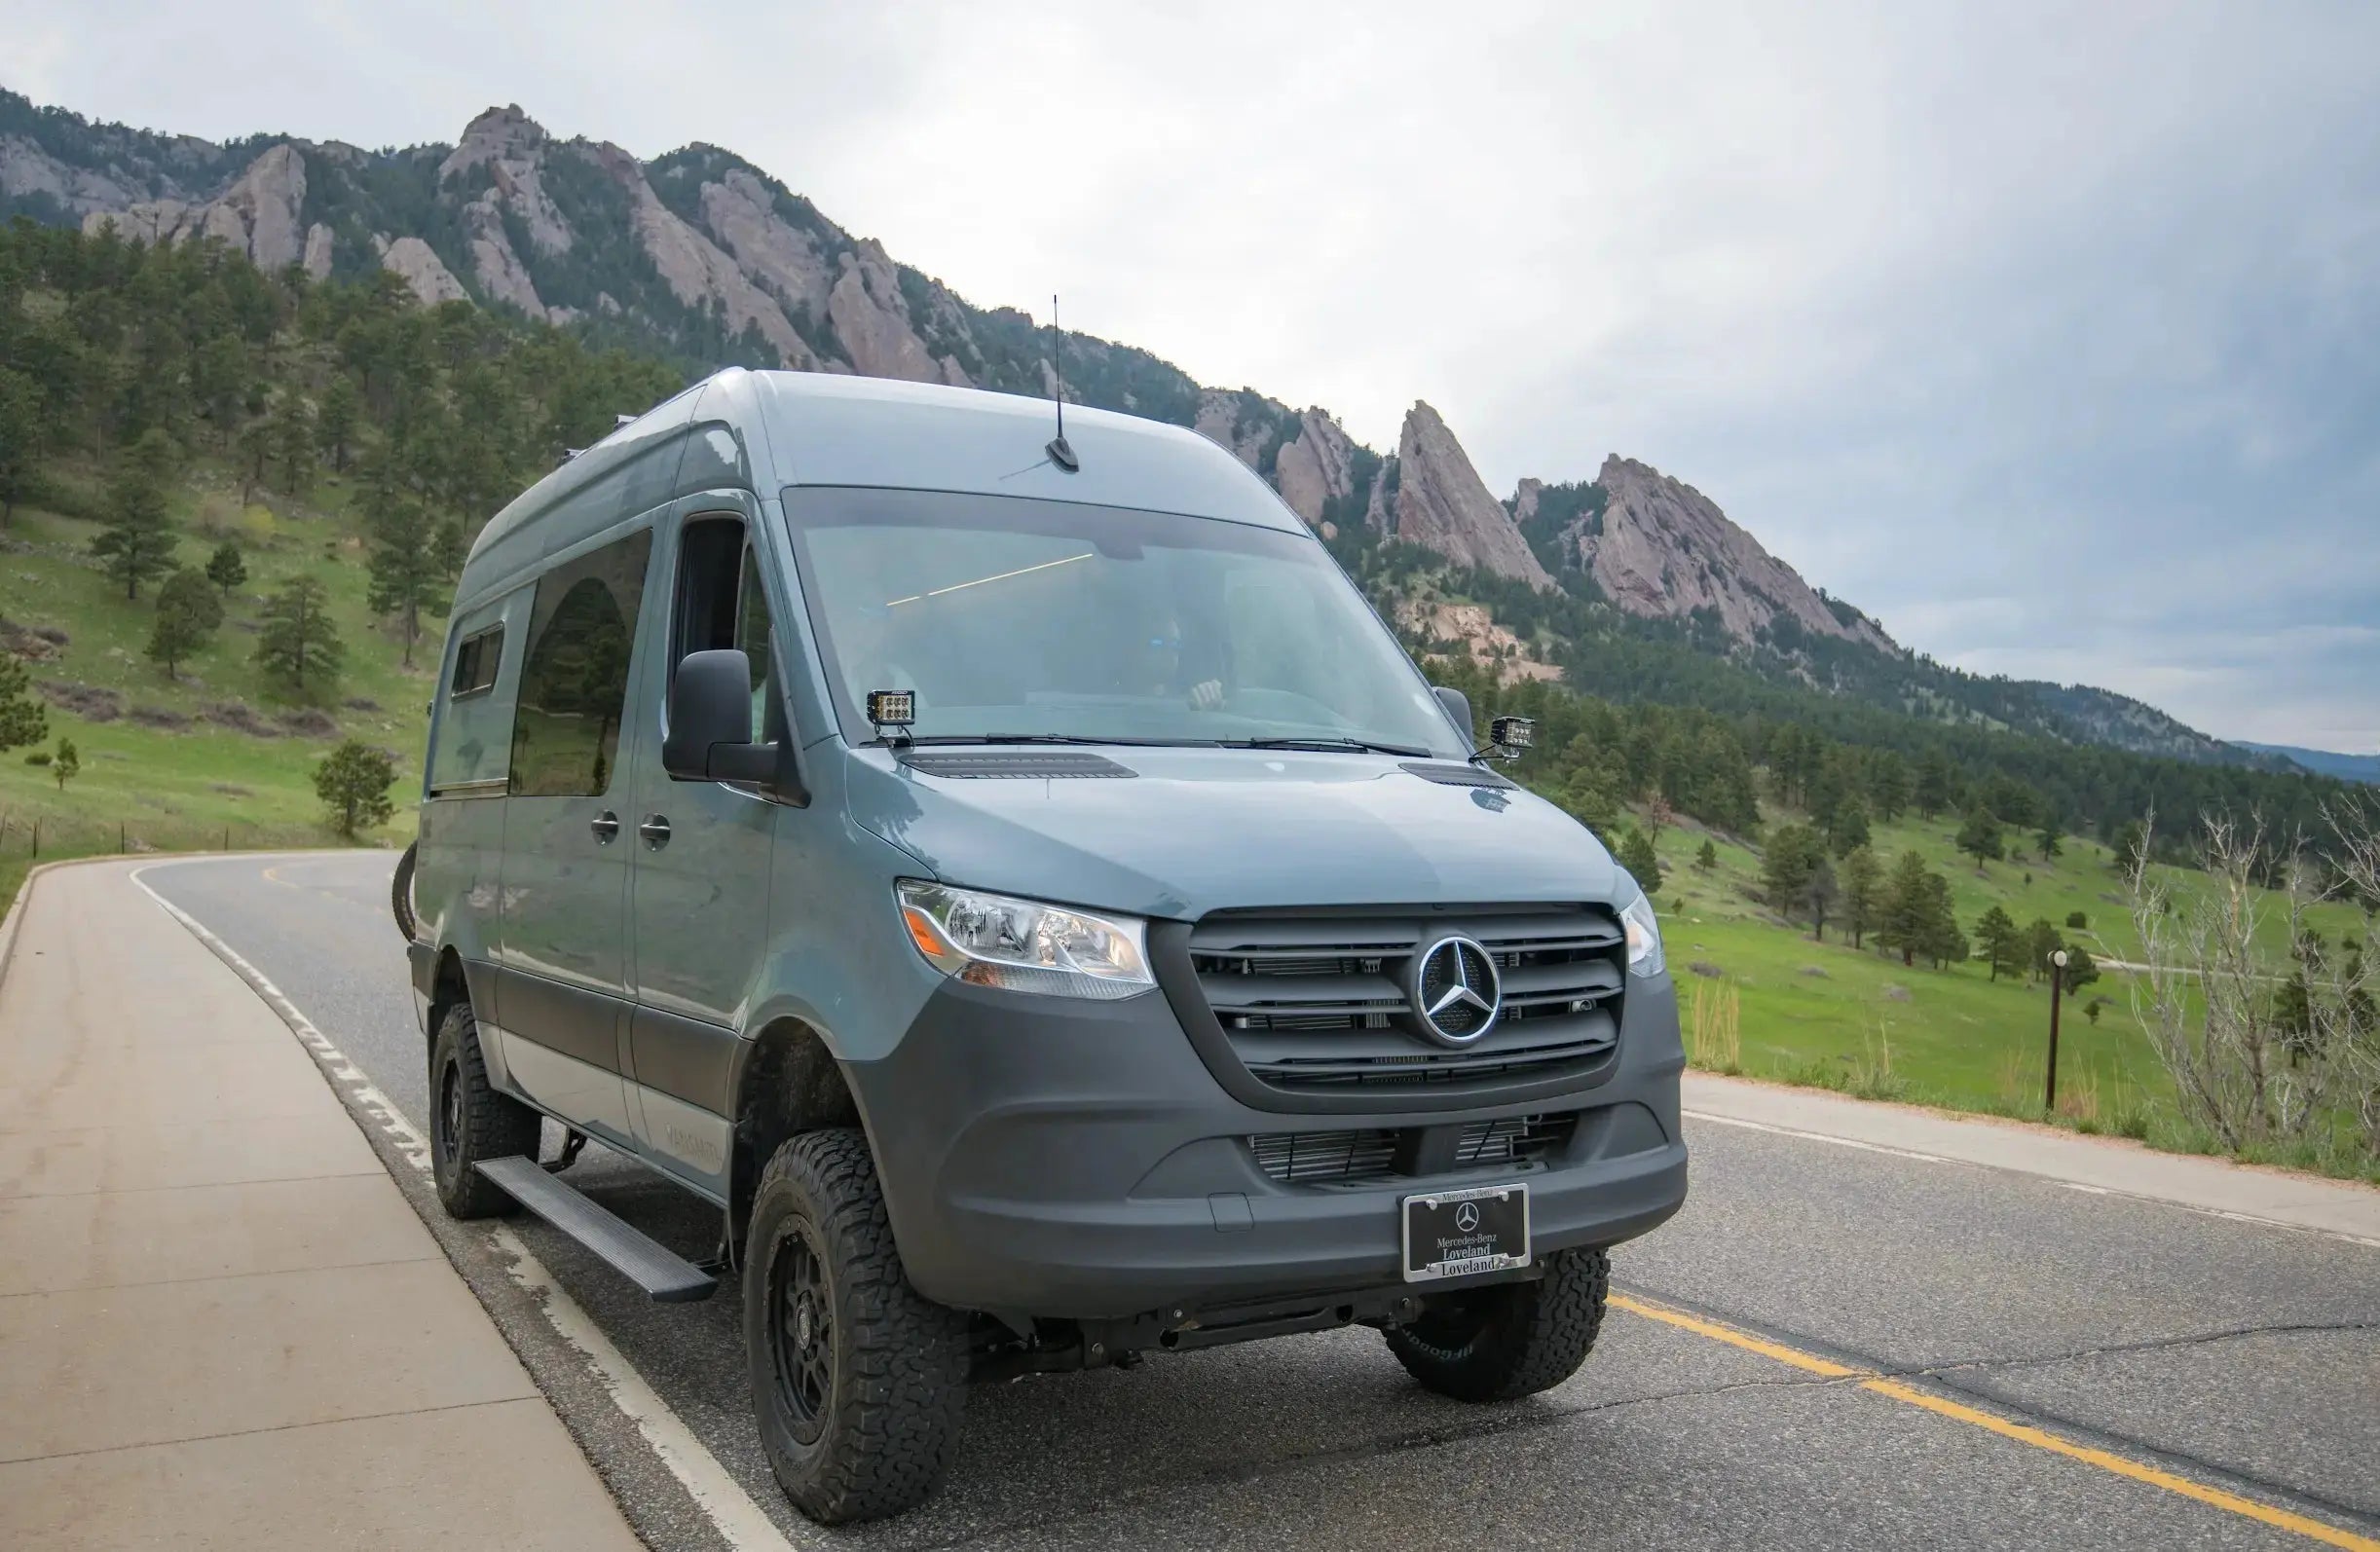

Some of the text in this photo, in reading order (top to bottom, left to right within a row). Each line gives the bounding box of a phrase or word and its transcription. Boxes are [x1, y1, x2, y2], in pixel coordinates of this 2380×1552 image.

[1436, 1233, 1497, 1249] Mercedes-Benz
[1442, 1244, 1491, 1261] Loveland
[1441, 1257, 1495, 1276] Loveland
